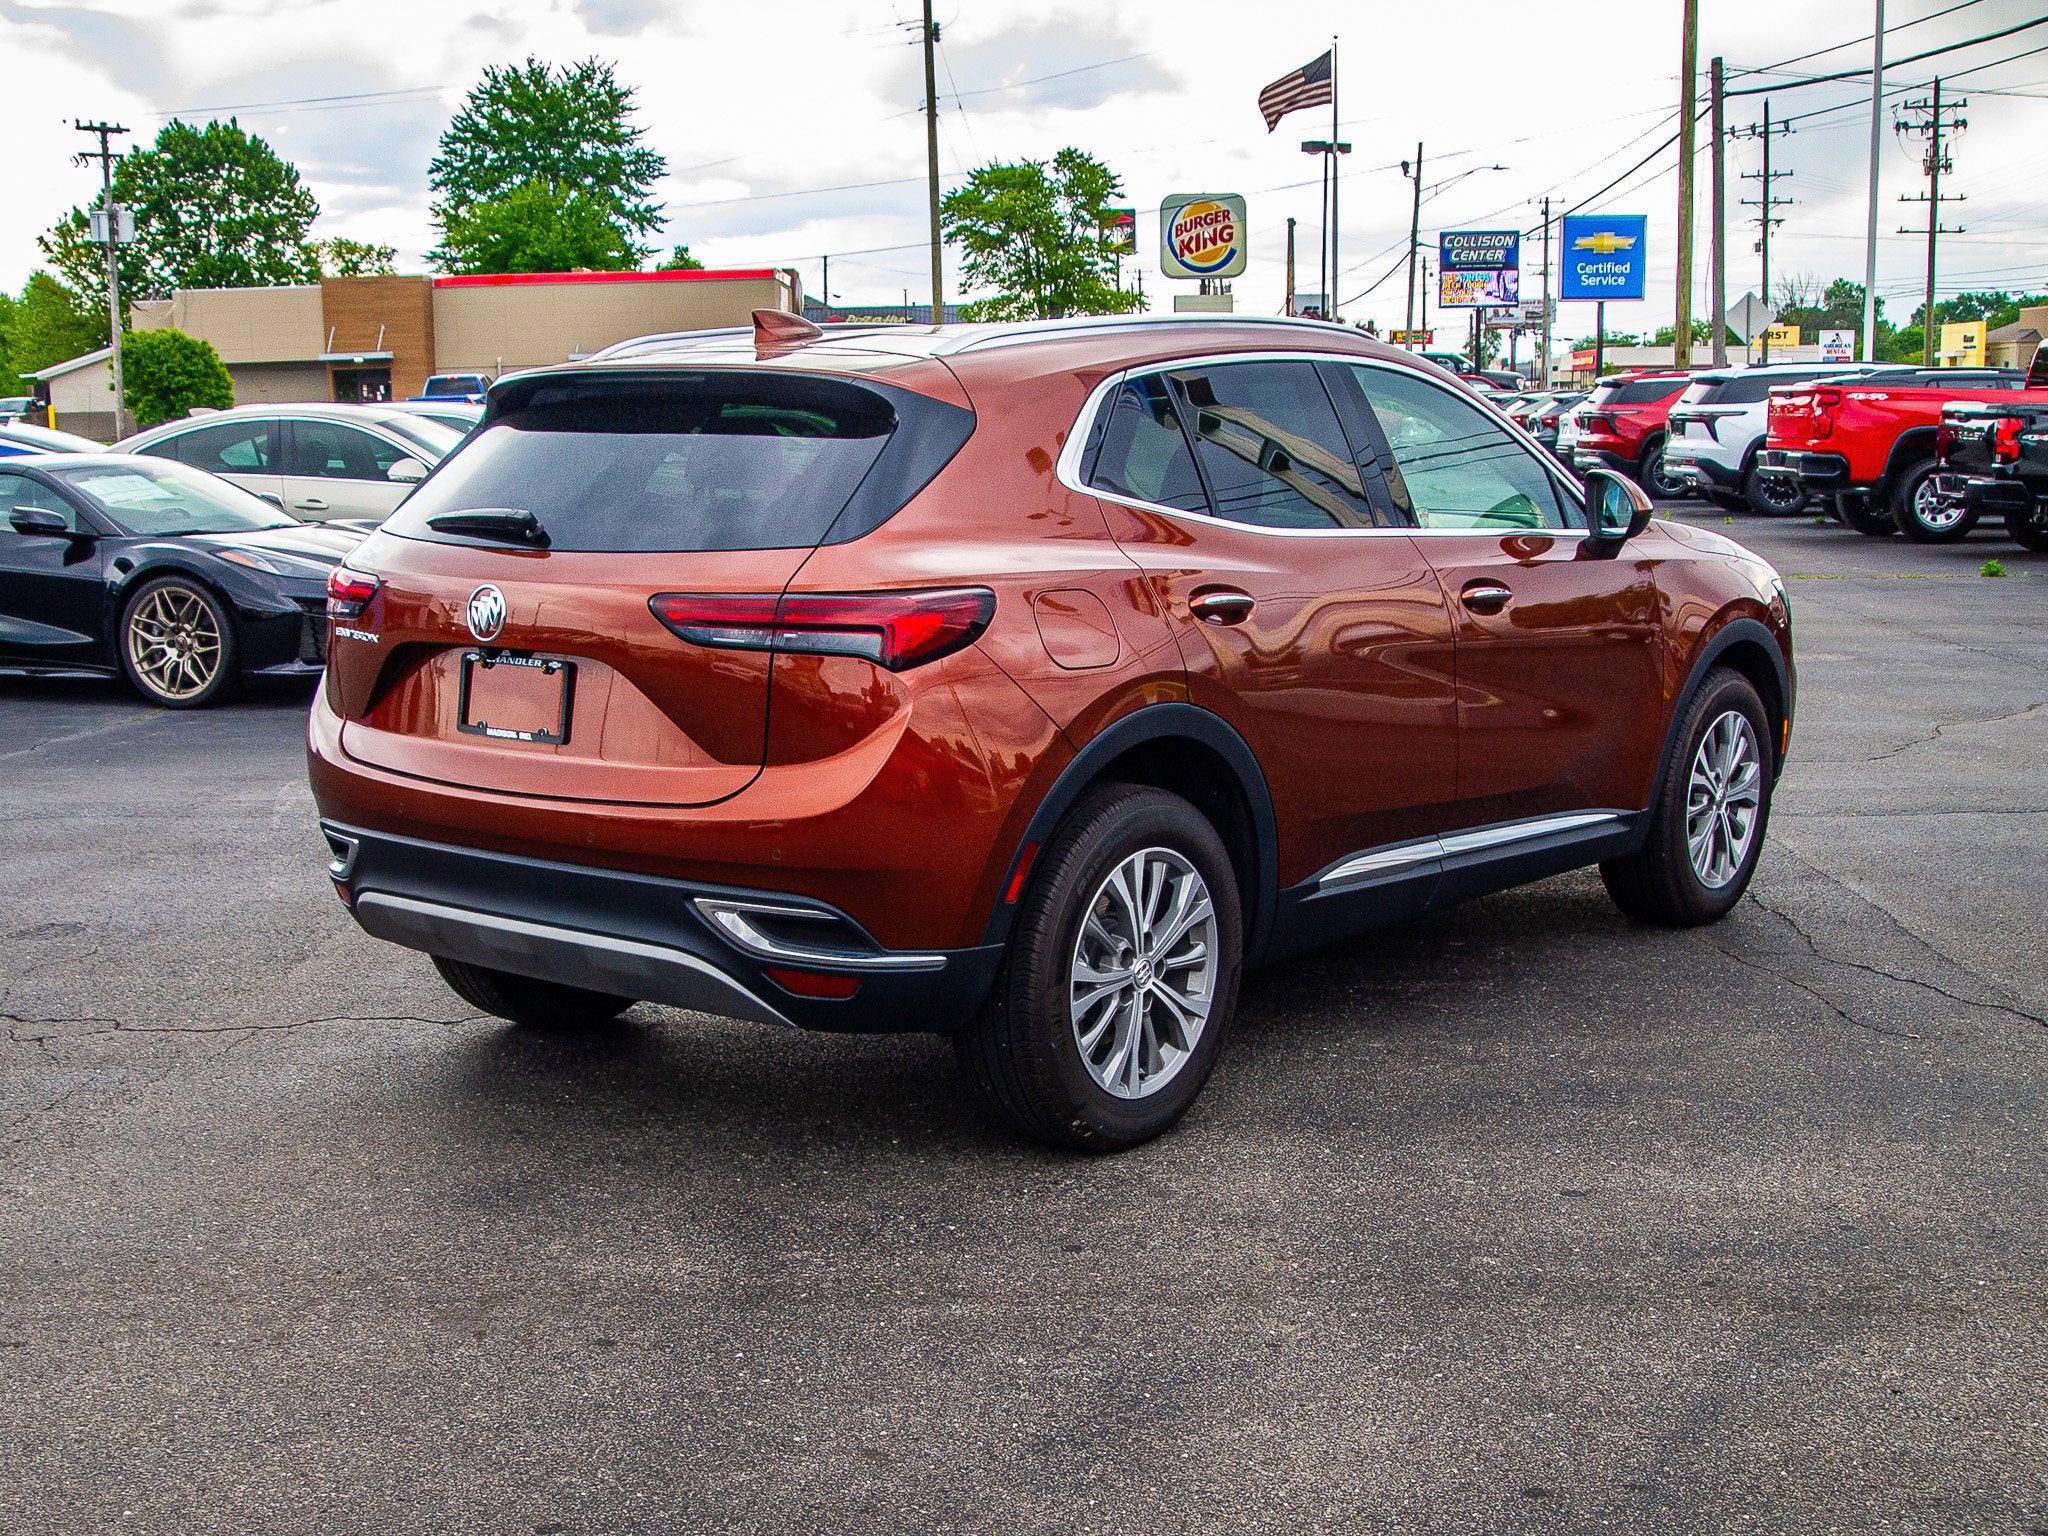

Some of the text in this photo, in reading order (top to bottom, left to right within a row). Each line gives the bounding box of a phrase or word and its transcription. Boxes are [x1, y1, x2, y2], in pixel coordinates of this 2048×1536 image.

[1175, 209, 1231, 239] BURGER
[1179, 224, 1234, 259] KING
[1444, 235, 1515, 247] COLLISION
[1451, 249, 1504, 261] CENTER
[1577, 262, 1631, 274] Certified
[1580, 274, 1626, 286] Service
